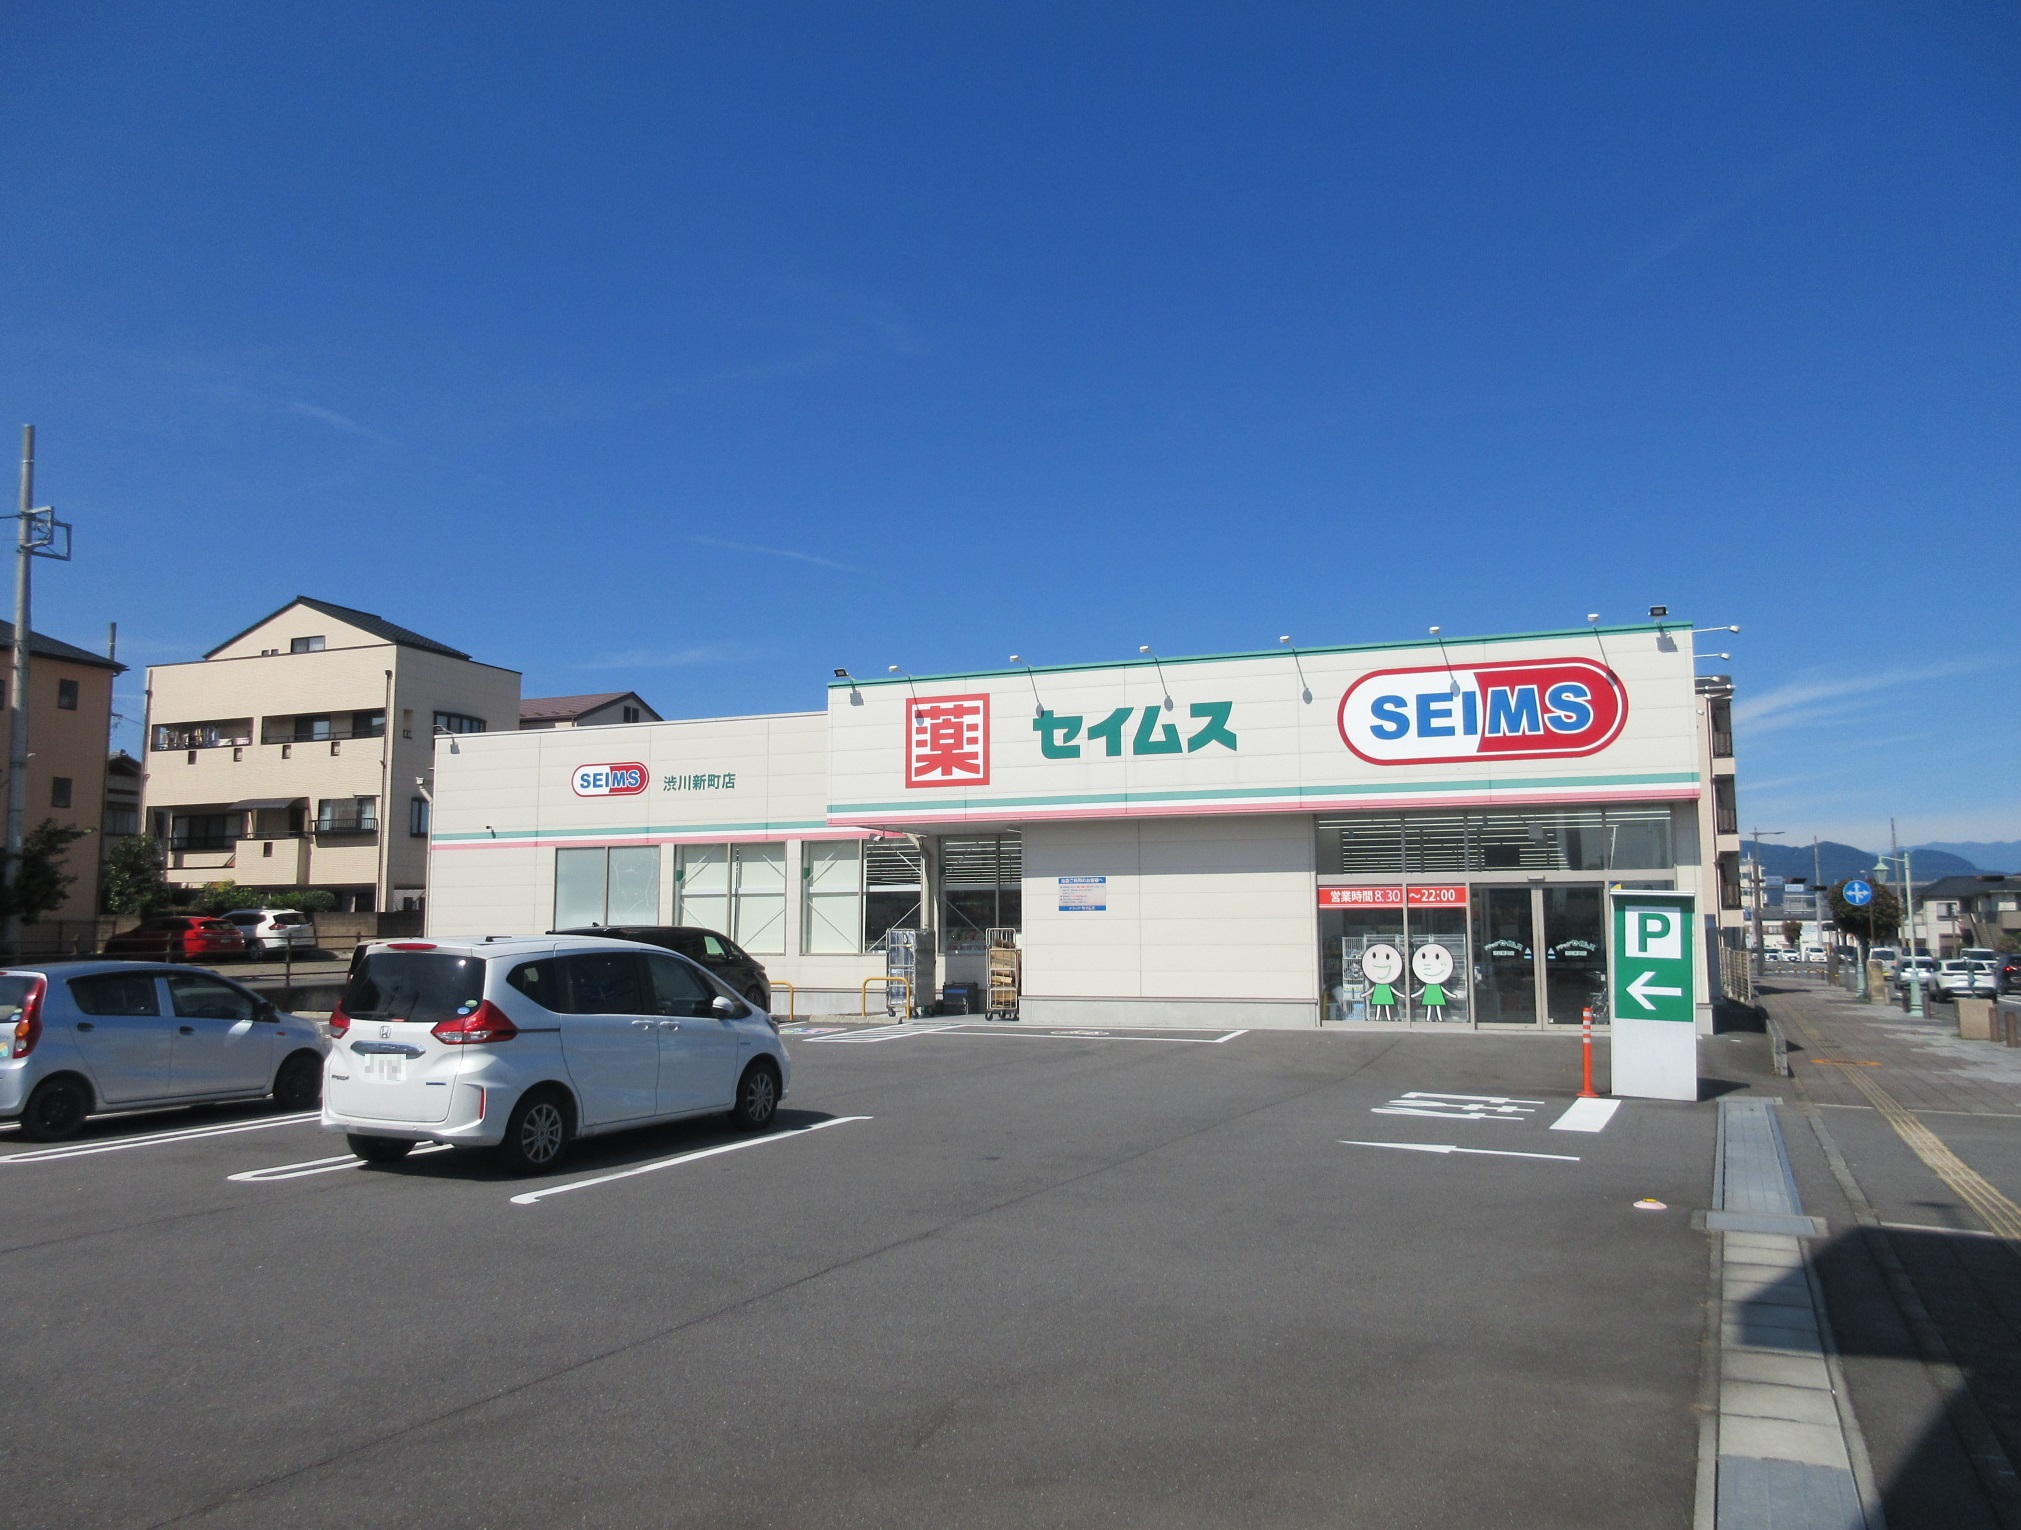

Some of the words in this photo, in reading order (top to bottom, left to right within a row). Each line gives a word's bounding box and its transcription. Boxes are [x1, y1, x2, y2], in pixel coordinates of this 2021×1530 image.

[1032, 700, 1238, 760] セイムス
[1369, 681, 1594, 741] SEIMS
[914, 704, 981, 777] 薬
[579, 769, 642, 790] SEIMS
[663, 772, 737, 792] 渋川新町店
[1637, 912, 1671, 953] P
